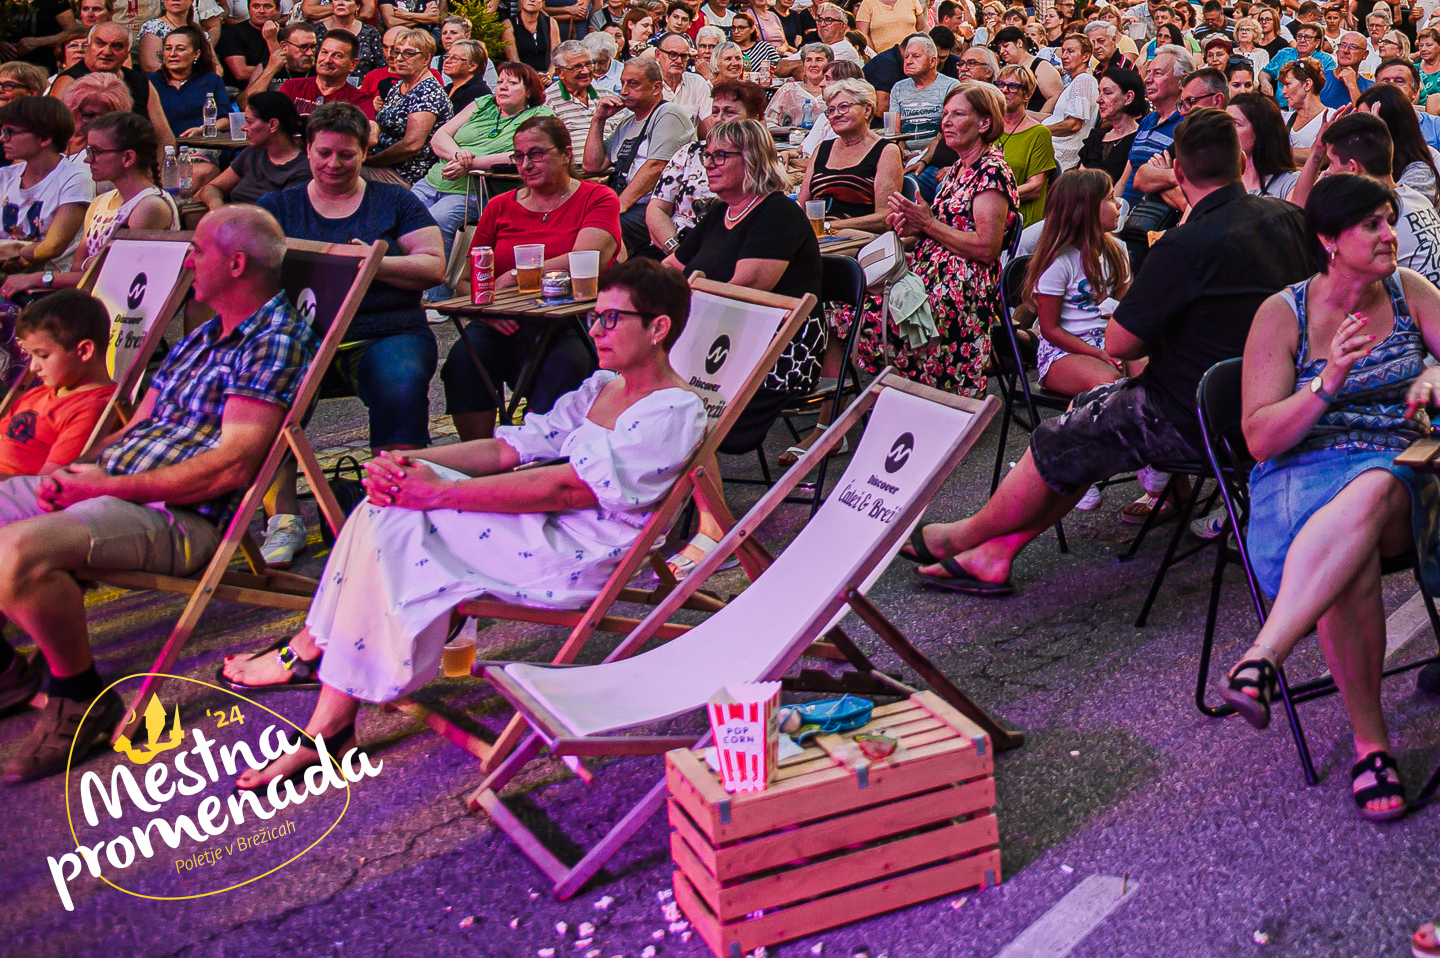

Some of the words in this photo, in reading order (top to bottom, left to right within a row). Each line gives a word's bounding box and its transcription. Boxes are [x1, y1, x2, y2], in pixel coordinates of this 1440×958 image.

[689, 375, 721, 392] Discover
[866, 474, 900, 495] Discover
[726, 727, 750, 735] POP
[723, 735, 755, 744] CORN
